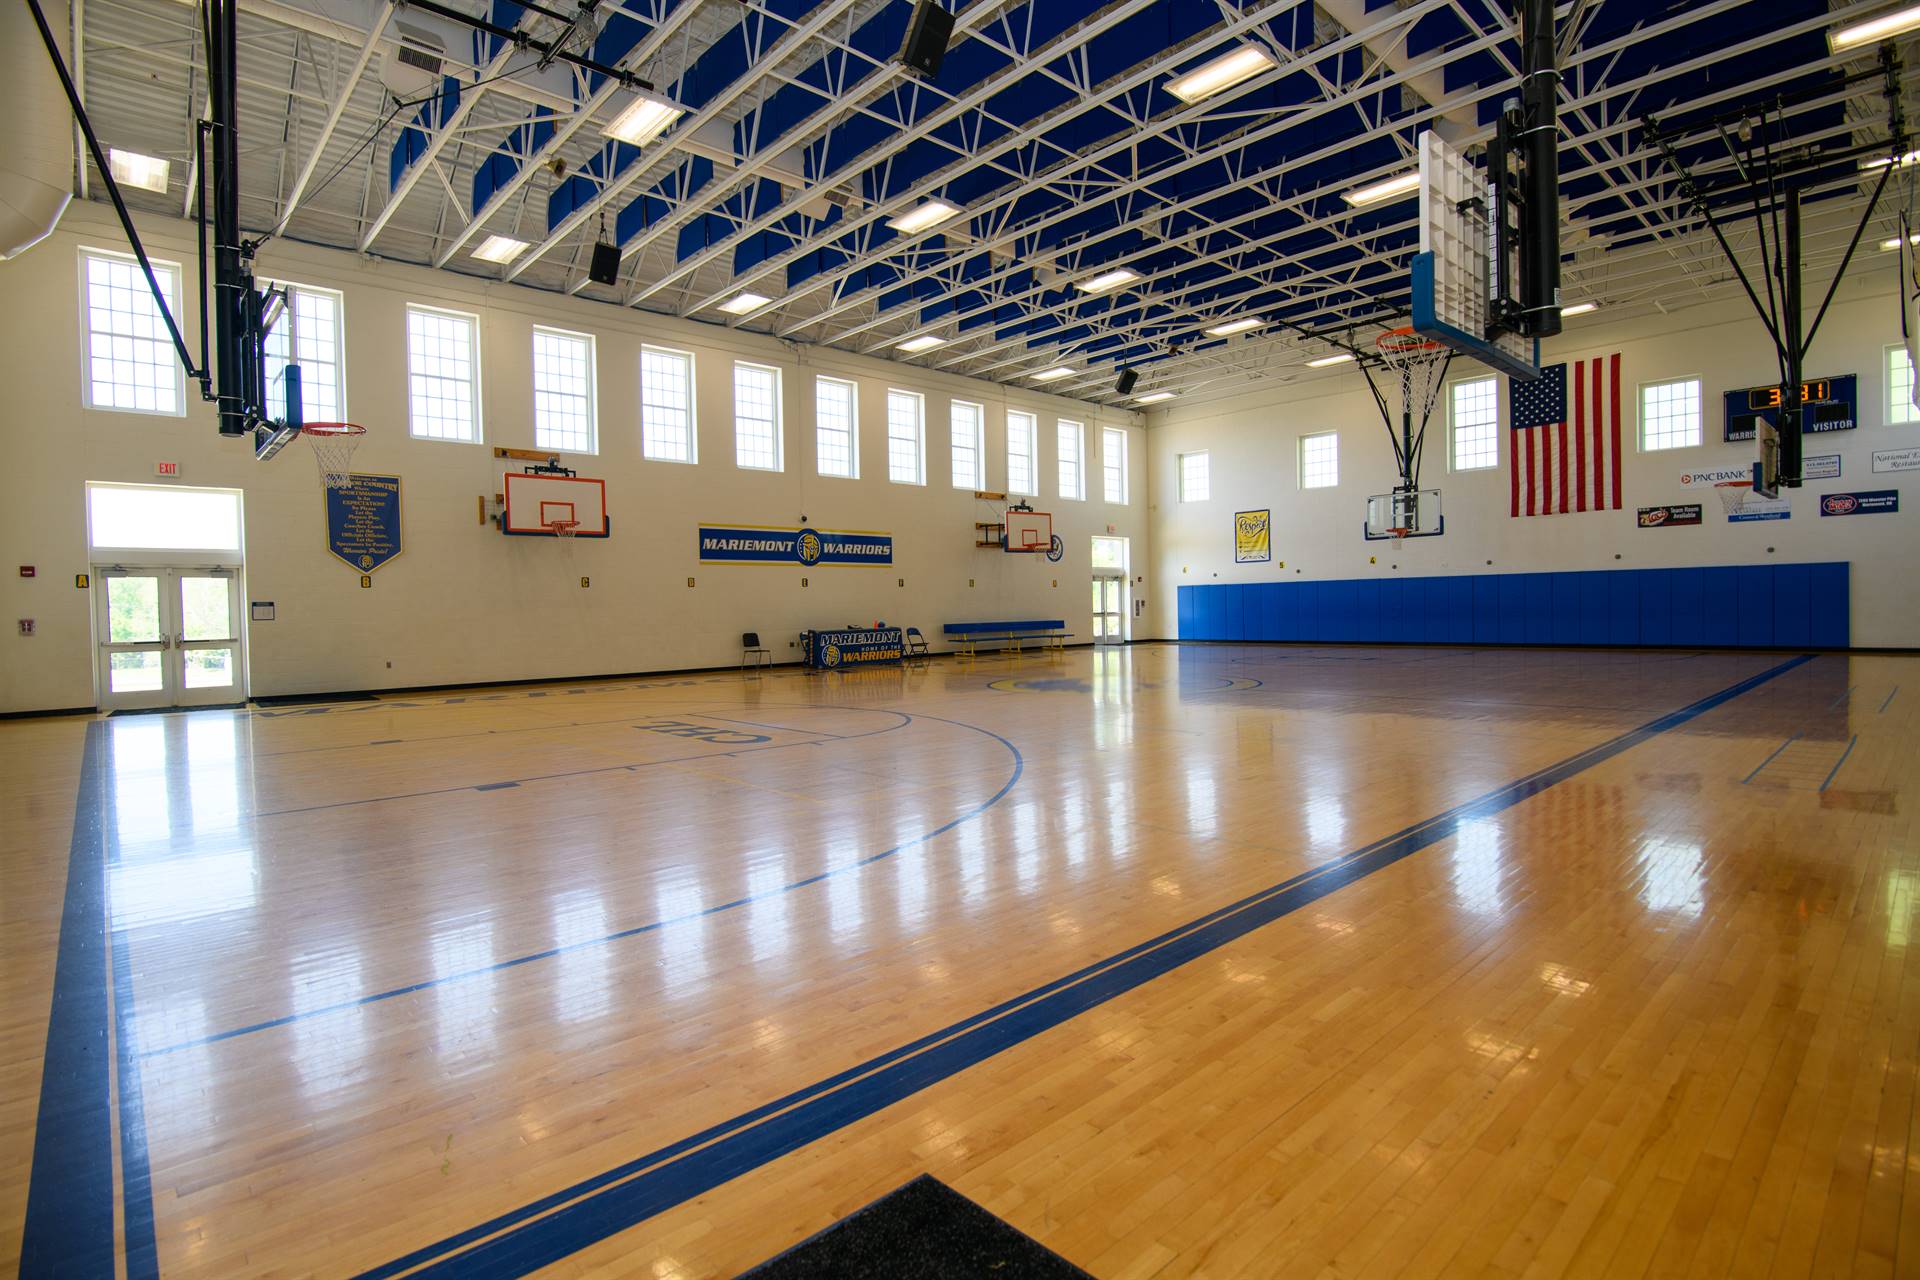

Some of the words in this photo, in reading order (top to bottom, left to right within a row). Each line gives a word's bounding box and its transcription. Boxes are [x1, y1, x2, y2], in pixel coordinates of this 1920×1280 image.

[1813, 420, 1853, 432] VISITOR
[1729, 431, 1757, 440] WARRIO
[159, 463, 176, 475] EXIT
[703, 538, 795, 552] MARIEMONT
[823, 542, 891, 556] WARRIORS
[77, 575, 88, 588] A
[362, 577, 370, 587] B
[820, 630, 900, 647] MARIEMONT
[842, 649, 901, 663] WARRIORS
